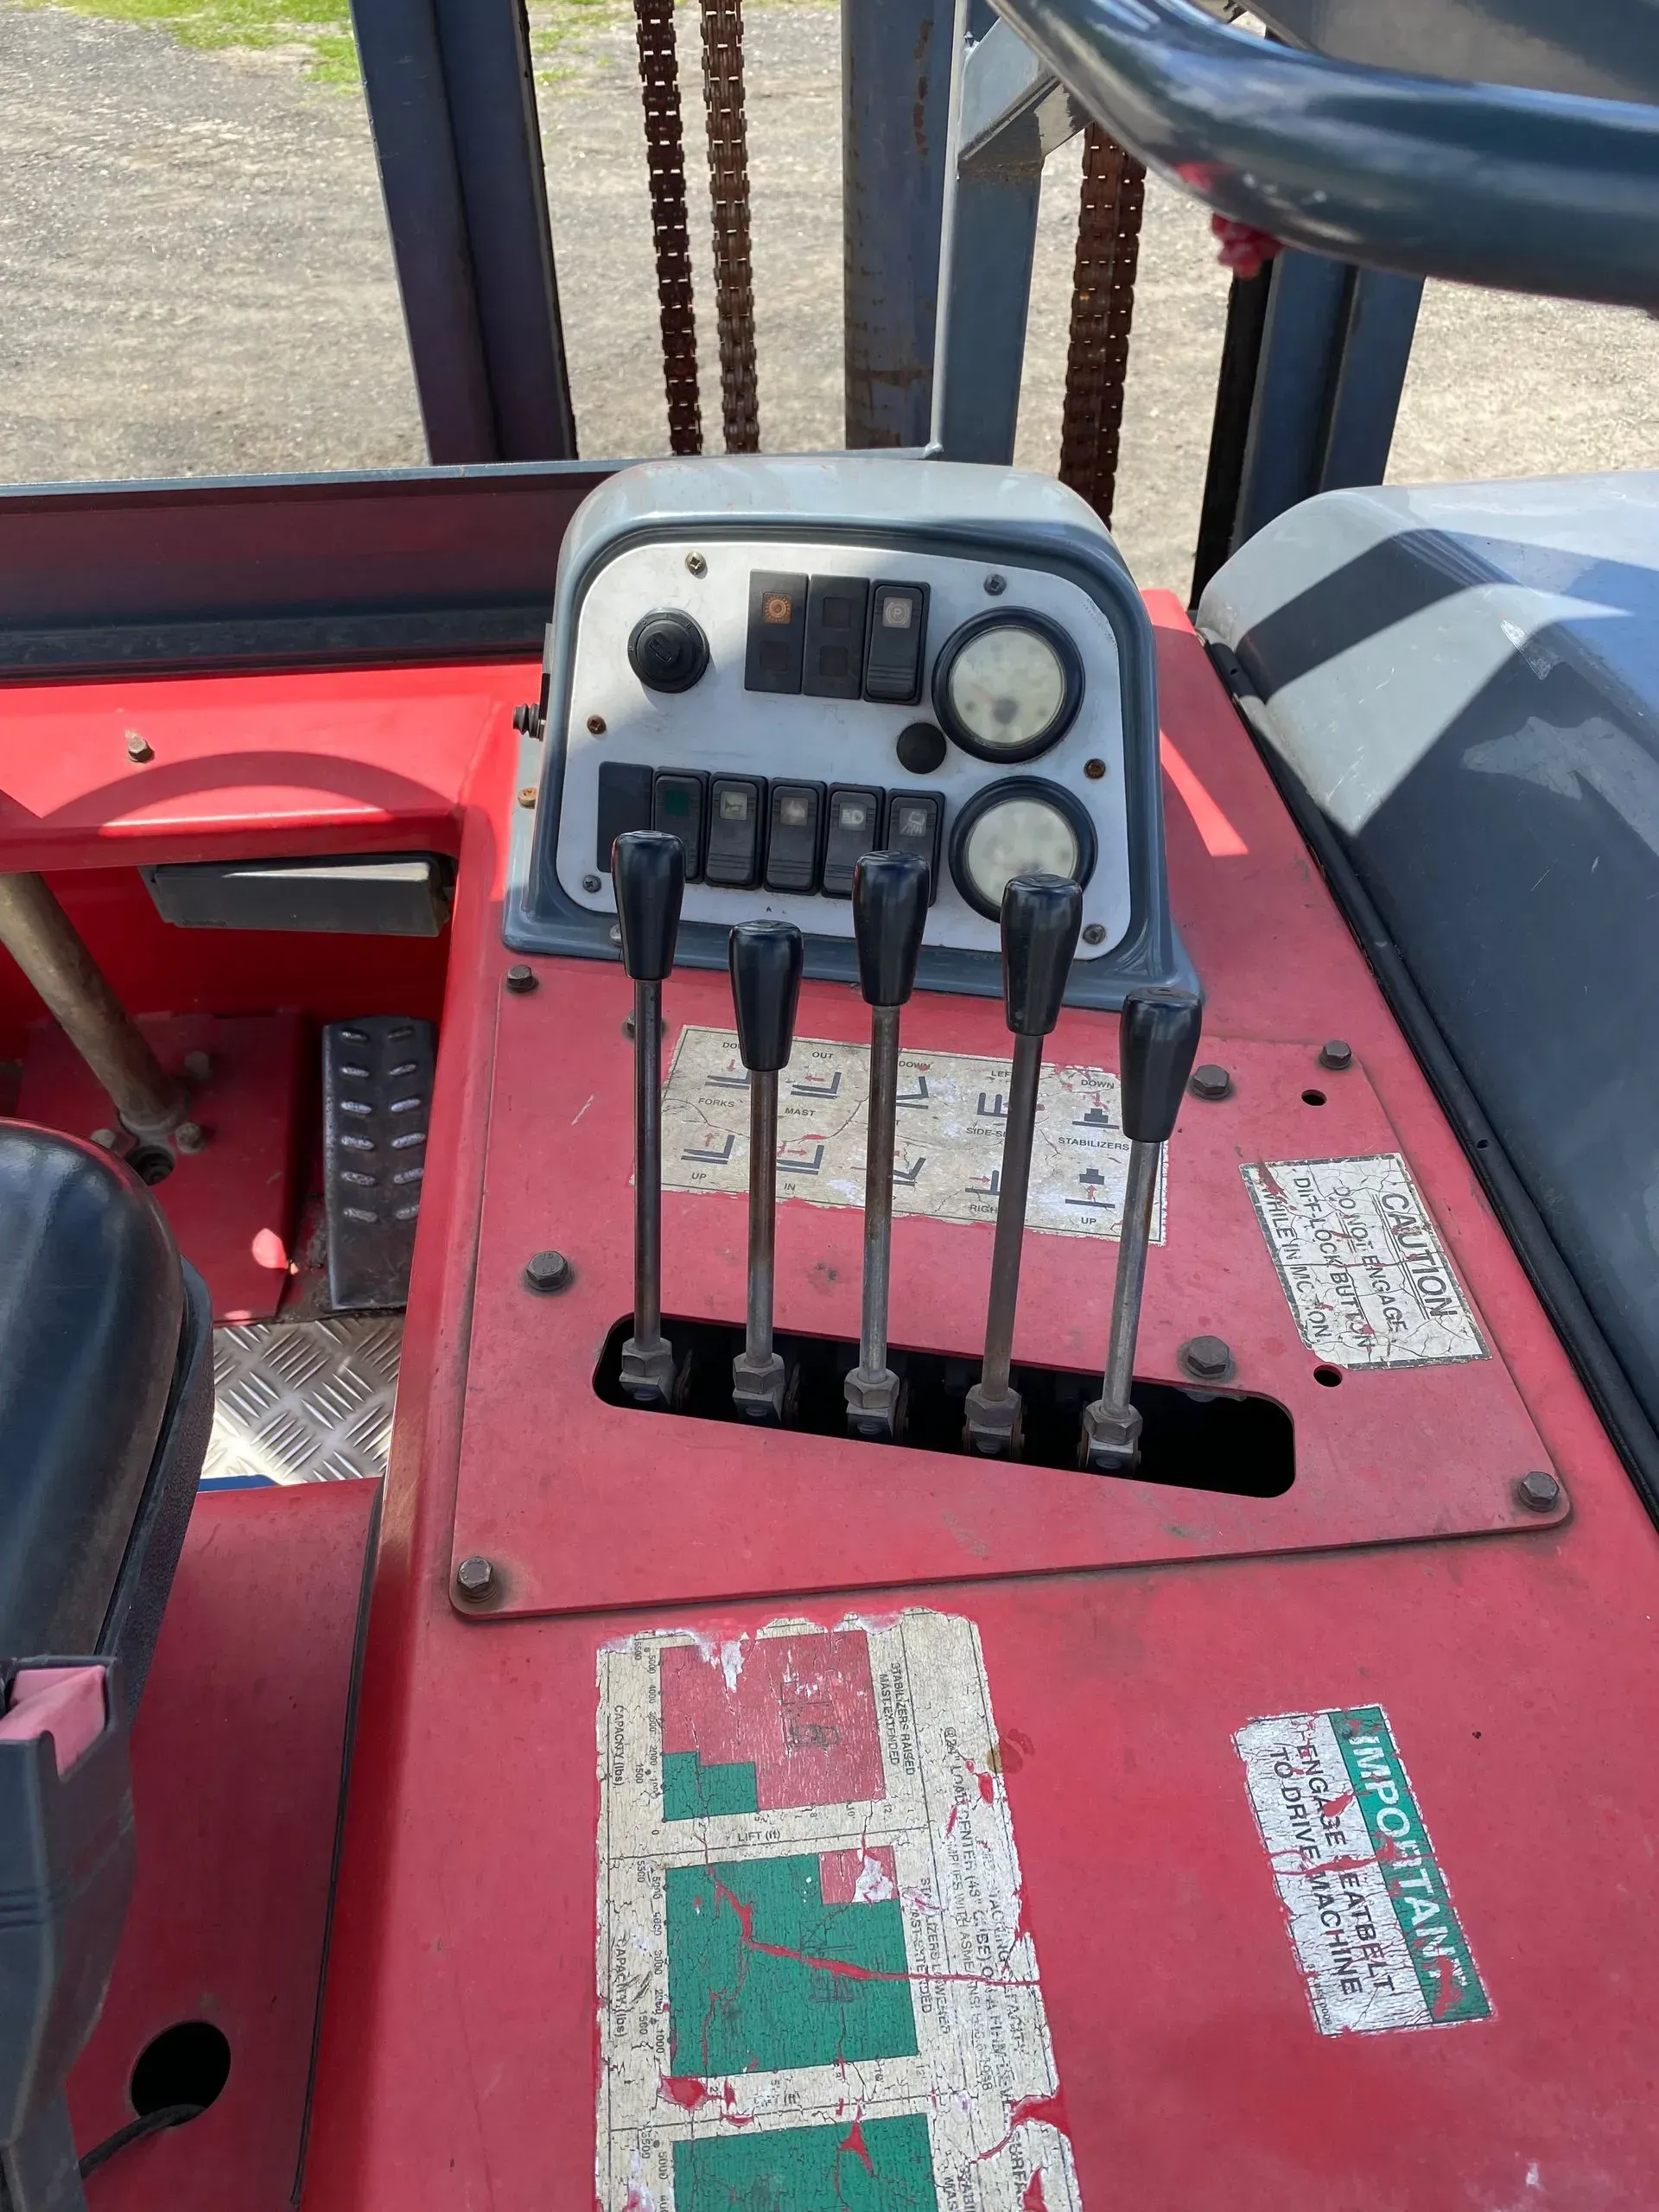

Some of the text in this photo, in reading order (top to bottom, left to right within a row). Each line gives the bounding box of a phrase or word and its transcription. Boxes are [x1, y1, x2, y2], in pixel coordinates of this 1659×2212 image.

[812, 1052, 835, 1060] OUT
[1081, 1079, 1115, 1090] DOWN
[698, 1097, 734, 1107] FORKS
[785, 1108, 817, 1117] MAST
[1058, 1136, 1129, 1151] STABILIZERS
[691, 1173, 707, 1181] UP
[784, 1182, 797, 1192] IN
[969, 1205, 998, 1215] RIGH
[1081, 1217, 1096, 1226] UP
[1262, 1188, 1295, 1239] WHILE
[1281, 1243, 1301, 1262] IN
[1292, 1177, 1376, 1349] DIFF-LOCK BUTTON
[1332, 1185, 1408, 1333] DO NOT ENGAGE
[1381, 1193, 1459, 1318] CAUTION
[648, 1655, 657, 1674] 5000
[648, 1685, 658, 1704] 4000
[879, 1674, 899, 1764] MAST EXTENDED
[890, 1662, 916, 1776] STABILIZERS RAISED
[613, 1705, 625, 1760] CAPACITY
[635, 1763, 644, 1784] 1500
[737, 1831, 782, 1842] LIFT (ft)
[1270, 1746, 1363, 1994] TO DRIVE MACHINE
[652, 1876, 662, 1899] 5000
[921, 1878, 940, 1960] STALIZERS
[1338, 1865, 1396, 1992] EATBELT
[656, 2028, 665, 2054] 1000
[658, 2152, 669, 2180] 5000
